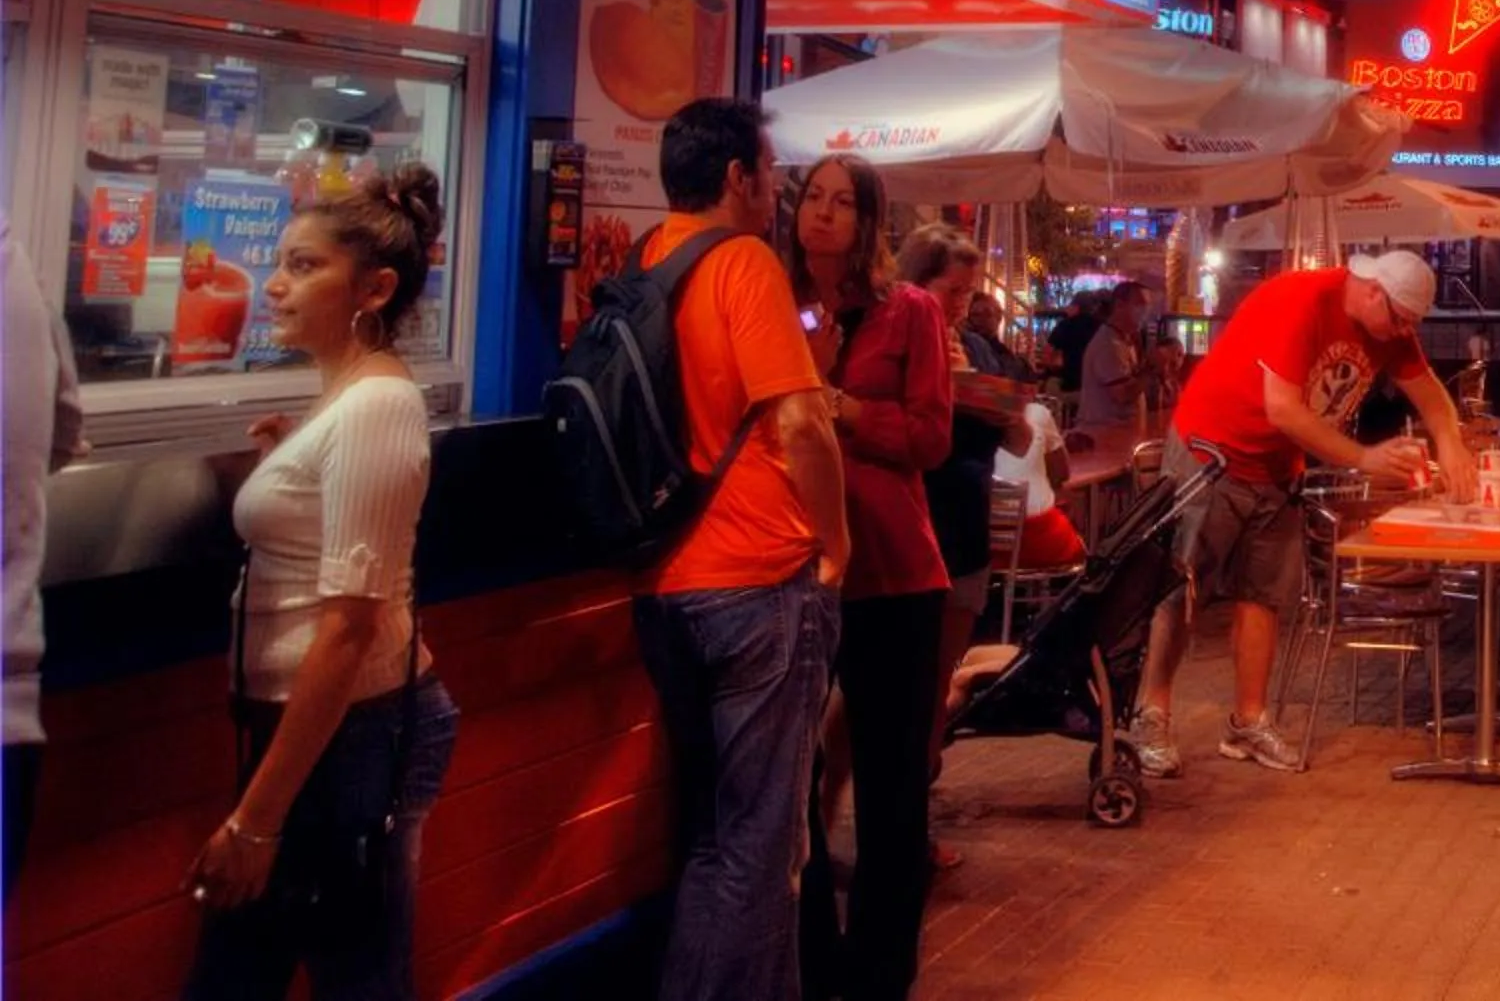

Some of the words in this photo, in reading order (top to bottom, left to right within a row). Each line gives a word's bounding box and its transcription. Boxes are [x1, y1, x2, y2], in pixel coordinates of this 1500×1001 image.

[1352, 59, 1478, 93] Boston
[857, 125, 941, 149] CANADIAN
[1444, 154, 1486, 167] SPORTS
[194, 186, 281, 214] Strawberry
